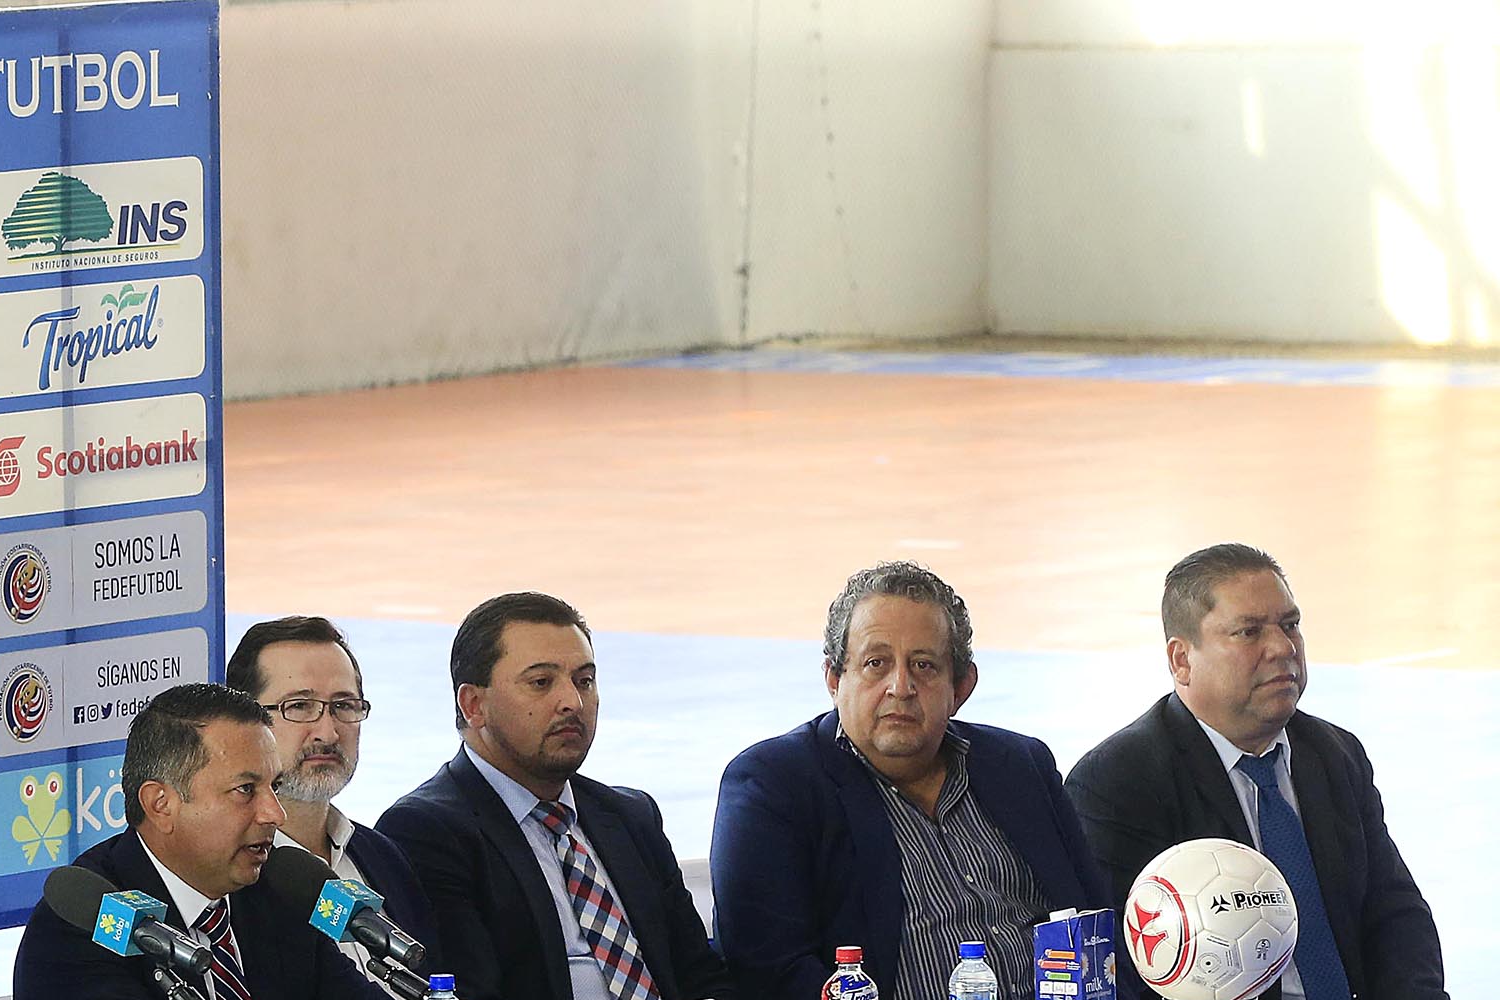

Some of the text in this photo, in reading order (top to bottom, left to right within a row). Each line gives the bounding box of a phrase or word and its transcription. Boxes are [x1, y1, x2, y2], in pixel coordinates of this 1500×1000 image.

[117, 200, 188, 246] INS
[31, 251, 159, 271] INSTITUTO NACIONAL DE SEGUROS
[23, 284, 159, 390] Tropical
[37, 429, 198, 479] Scotiabank
[94, 533, 181, 570] SOMOS LA
[93, 569, 183, 602] FEDEFUTBOL
[97, 656, 181, 688] SÍGANOS EN
[1086, 976, 1103, 993] milk
